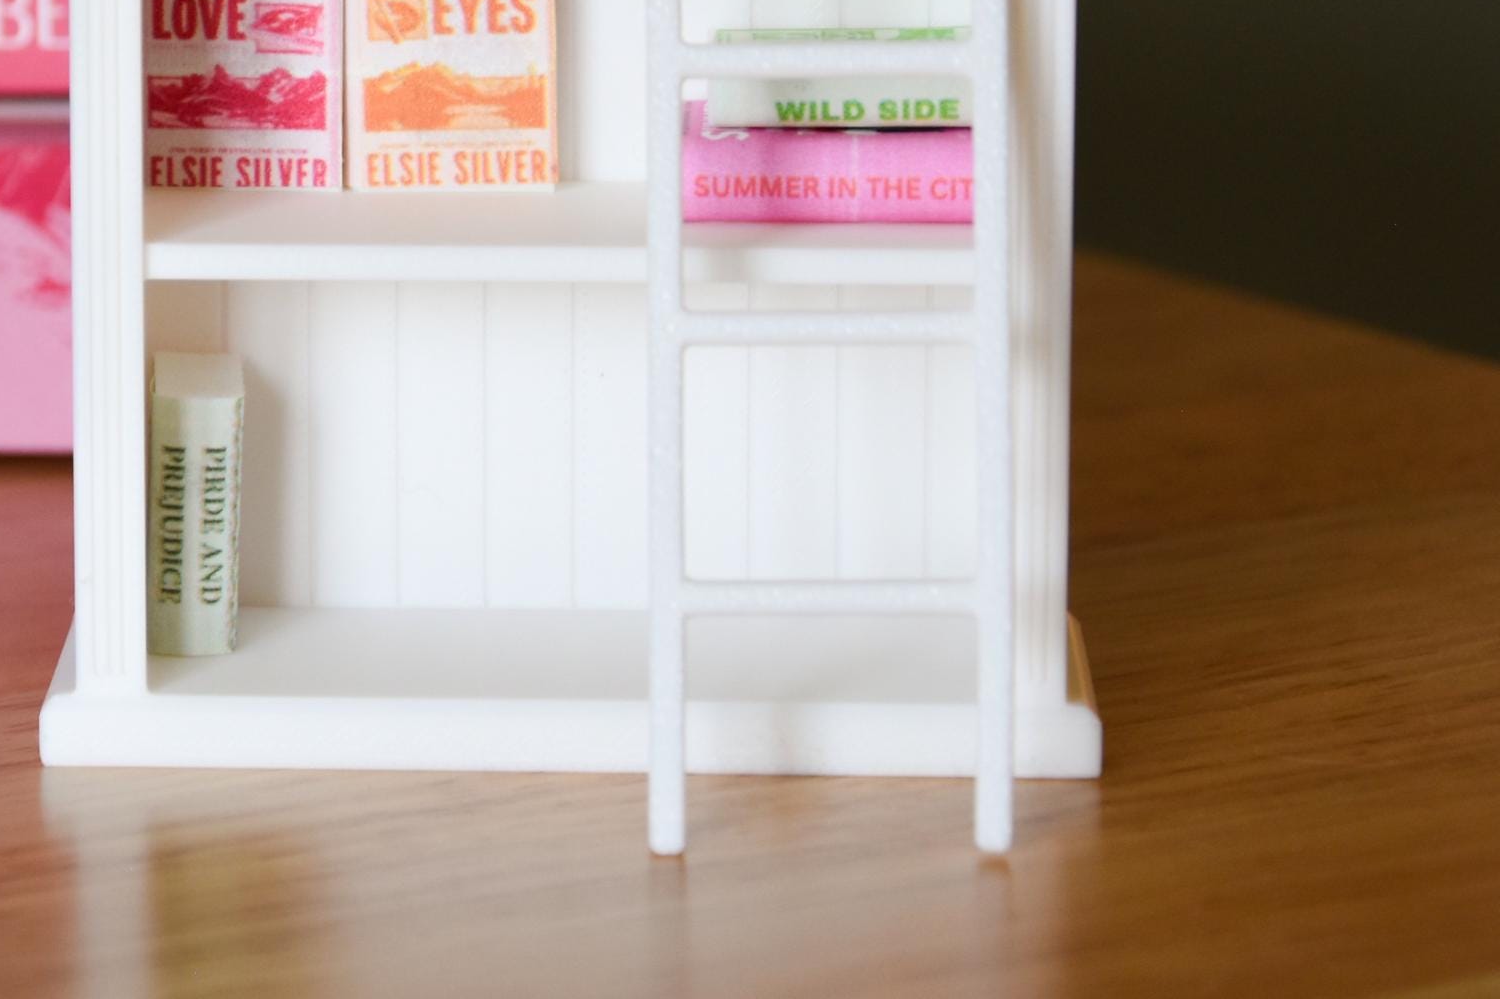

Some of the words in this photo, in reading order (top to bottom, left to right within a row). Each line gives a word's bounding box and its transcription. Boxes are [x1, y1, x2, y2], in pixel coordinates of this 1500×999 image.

[775, 100, 865, 122] WILD
[878, 99, 960, 121] SIDE
[150, 156, 223, 188] ELSIE
[235, 156, 328, 188] SILVER
[367, 152, 443, 187] ELSIE
[454, 149, 549, 186] SILVER
[693, 174, 821, 200] SUMMER
[828, 176, 857, 200] IN
[868, 177, 922, 201] THE
[158, 445, 186, 604] PREJUDICE
[200, 542, 225, 605] AND
